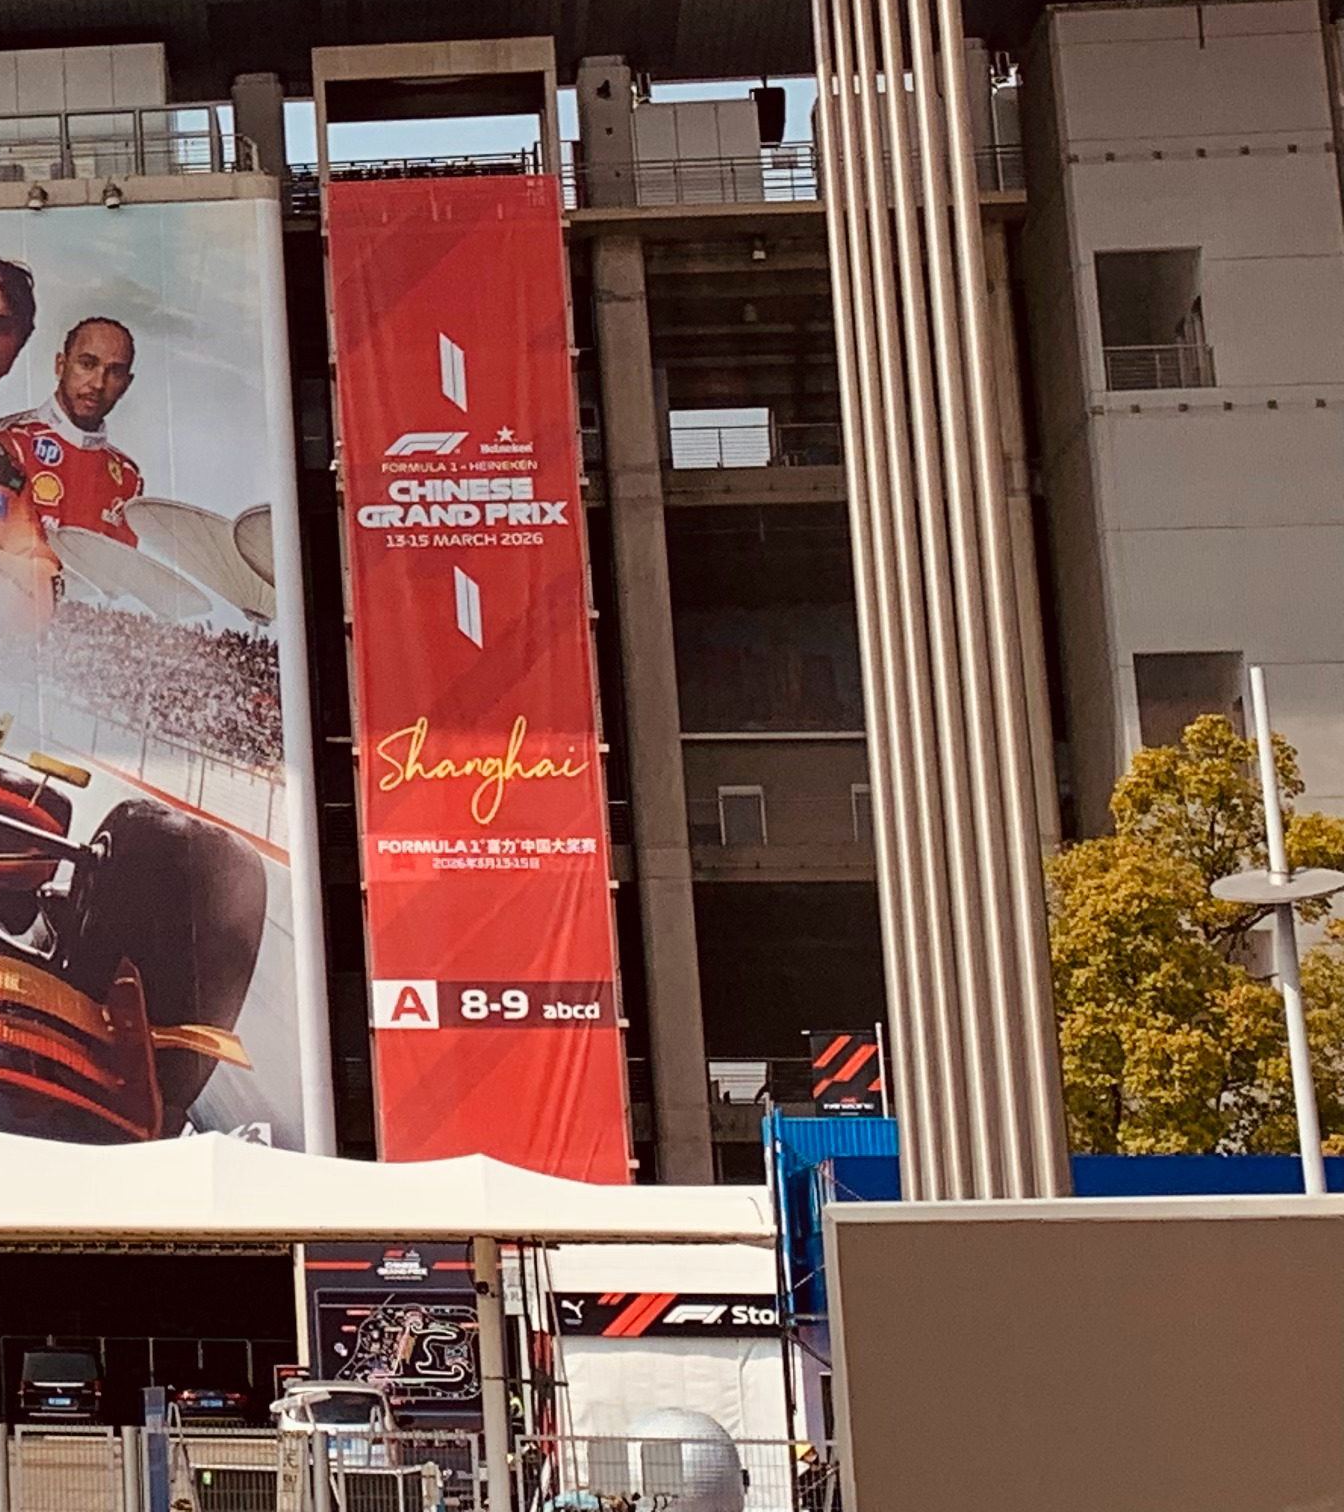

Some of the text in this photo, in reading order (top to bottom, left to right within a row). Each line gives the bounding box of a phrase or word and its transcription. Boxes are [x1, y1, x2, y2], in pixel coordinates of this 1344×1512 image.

[381, 461, 446, 473] FORMULA
[469, 459, 537, 471] HEINEKEN
[388, 477, 533, 502] CHINESE
[357, 501, 568, 528] GRAND PRIX
[386, 532, 544, 547] 13-15 MARCH 2026
[377, 715, 589, 824] Shanghai
[378, 839, 468, 854] FORMULA
[391, 986, 600, 1021] A 8-9 abcd
